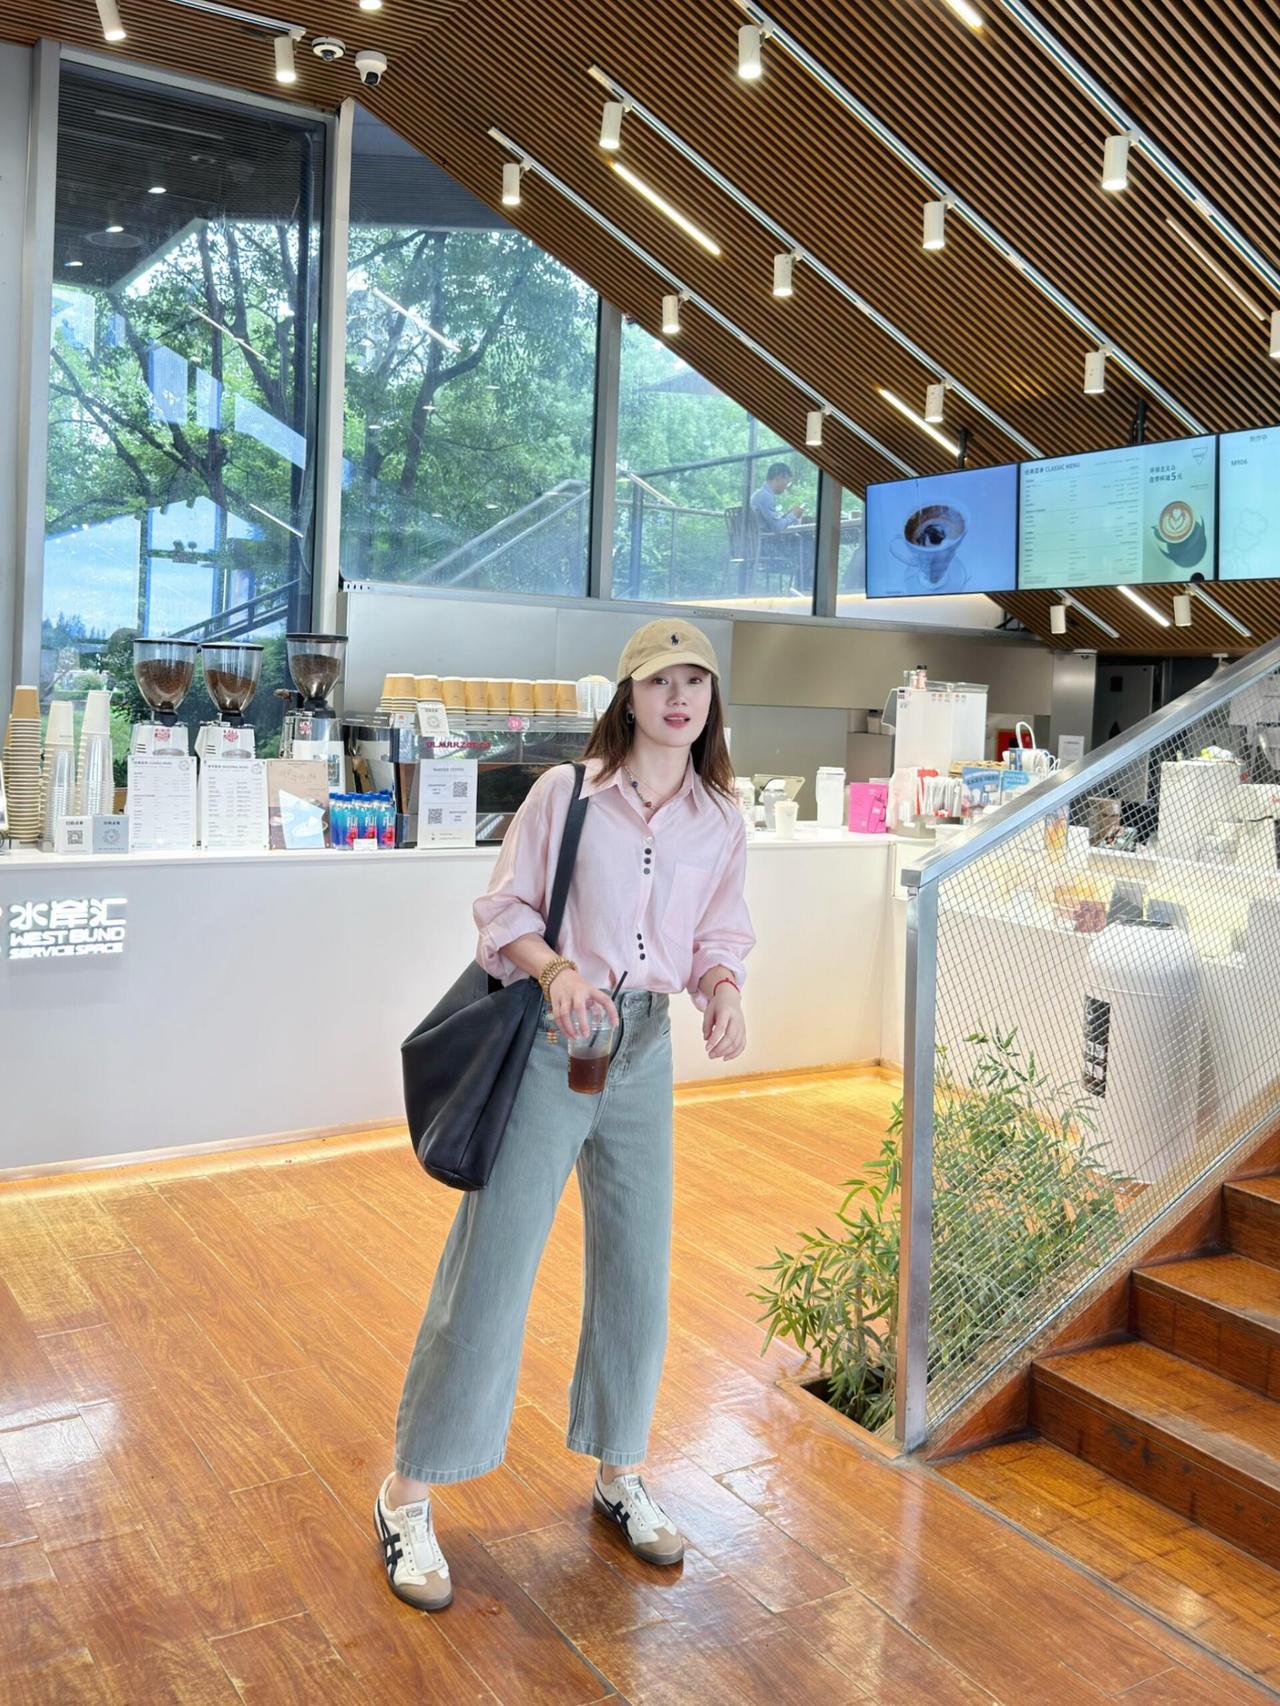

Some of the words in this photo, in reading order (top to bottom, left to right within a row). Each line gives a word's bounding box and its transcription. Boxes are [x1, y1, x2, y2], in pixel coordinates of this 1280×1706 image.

[9, 898, 128, 930] 水岸汇
[10, 931, 68, 947] WEST
